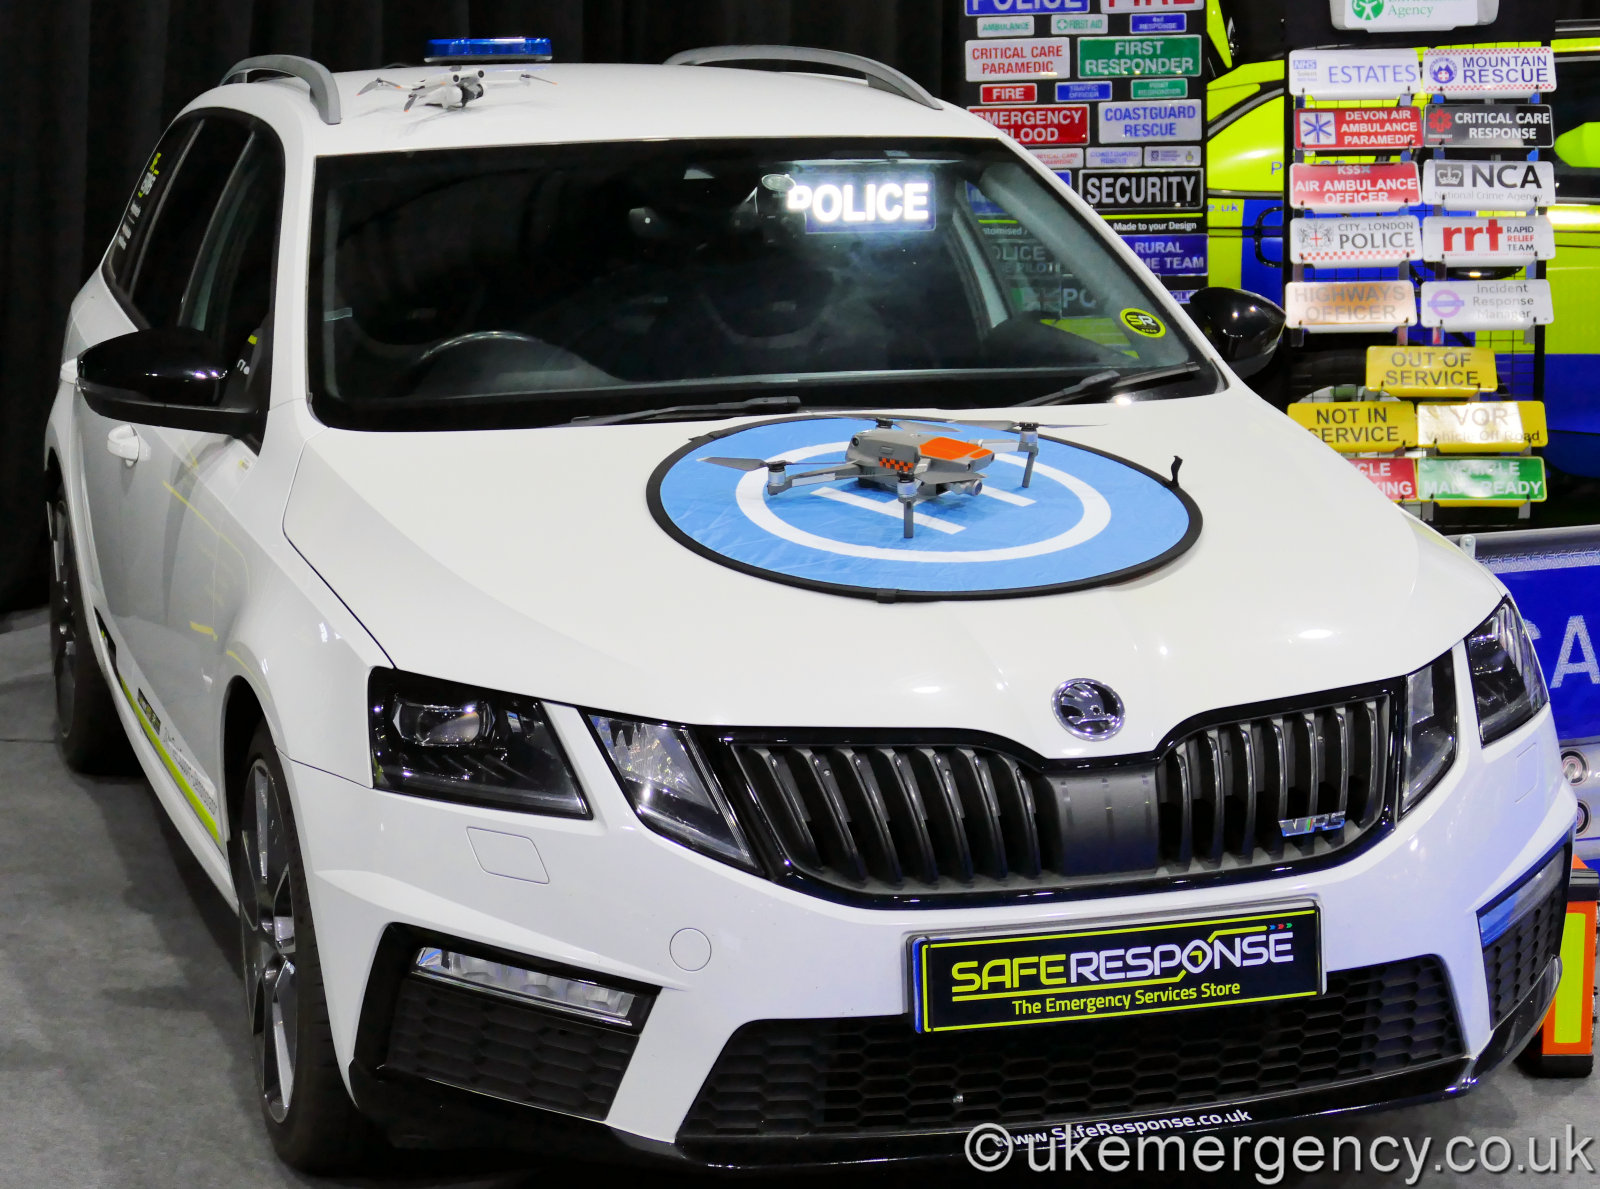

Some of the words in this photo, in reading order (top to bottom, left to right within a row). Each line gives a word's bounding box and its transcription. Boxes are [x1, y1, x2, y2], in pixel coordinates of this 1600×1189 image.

[1388, 4, 1434, 18] Agency
[982, 21, 1030, 31] AMBULANCE
[1068, 16, 1088, 28] FIRST
[1090, 16, 1102, 27] AID
[972, 47, 1026, 60] CRITICAL
[1031, 45, 1063, 58] CARE
[1114, 41, 1164, 55] FIRST
[981, 60, 1054, 74] PARAMEDIC
[1084, 57, 1194, 74] RESPONDER
[1293, 60, 1317, 69] NHS
[1463, 55, 1547, 68] MOUNTAIN
[1328, 64, 1416, 84] ESTATES
[1463, 68, 1549, 83] RESCUE
[992, 87, 1025, 100] FIRE
[1104, 105, 1196, 121] COASTGUARD
[1345, 110, 1387, 121] DEVON
[1390, 109, 1411, 120] AIR
[1455, 112, 1512, 124] CRITICAL
[1515, 111, 1550, 124] CARE
[1124, 123, 1177, 137] RESCUE
[1341, 122, 1417, 133] AMBULANCE
[1468, 127, 1537, 140] RESPONSE
[1344, 134, 1416, 145] PARAMEDIC
[1337, 165, 1361, 174] KSS
[1472, 164, 1542, 189] NCA
[1086, 176, 1197, 204] SECURITY
[1295, 180, 1321, 192] AIR
[1323, 178, 1417, 192] AMBULANCE
[786, 182, 930, 223] POLICE
[1324, 192, 1389, 204] OFFICER
[1434, 191, 1474, 201] National
[1476, 191, 1505, 201] Crime
[1507, 192, 1543, 203] Agency
[1114, 222, 1136, 231] Made
[1149, 223, 1166, 233] your
[1169, 221, 1197, 231] Design
[1338, 223, 1360, 232] CITY
[1368, 222, 1414, 231] LONDON
[1507, 225, 1534, 234] RAPID
[1339, 231, 1414, 250] POLICE
[1442, 219, 1503, 252] rrt
[1507, 234, 1535, 242] RELIEF
[1135, 241, 1184, 254] RURAL
[1507, 243, 1535, 252] TEAM
[1165, 256, 1204, 269] TEAM
[1294, 285, 1406, 303] HIGHWAYS
[1477, 283, 1529, 294] Incident
[1473, 296, 1534, 308] Response
[1305, 304, 1396, 322] OFFICER
[1126, 314, 1157, 326] SR
[1391, 351, 1437, 368] OUT
[1442, 352, 1472, 368] OF
[1385, 370, 1479, 387] SERVICE
[1316, 408, 1360, 424] NOT
[1368, 407, 1387, 423] IN
[1454, 408, 1508, 426] VOR
[1504, 430, 1540, 441] Road
[952, 931, 1294, 993] SAFERESPONSE
[1012, 1000, 1042, 1015] The
[1046, 993, 1131, 1014] Emergency
[1135, 987, 1198, 1005] Services
[1201, 982, 1241, 998] Store
